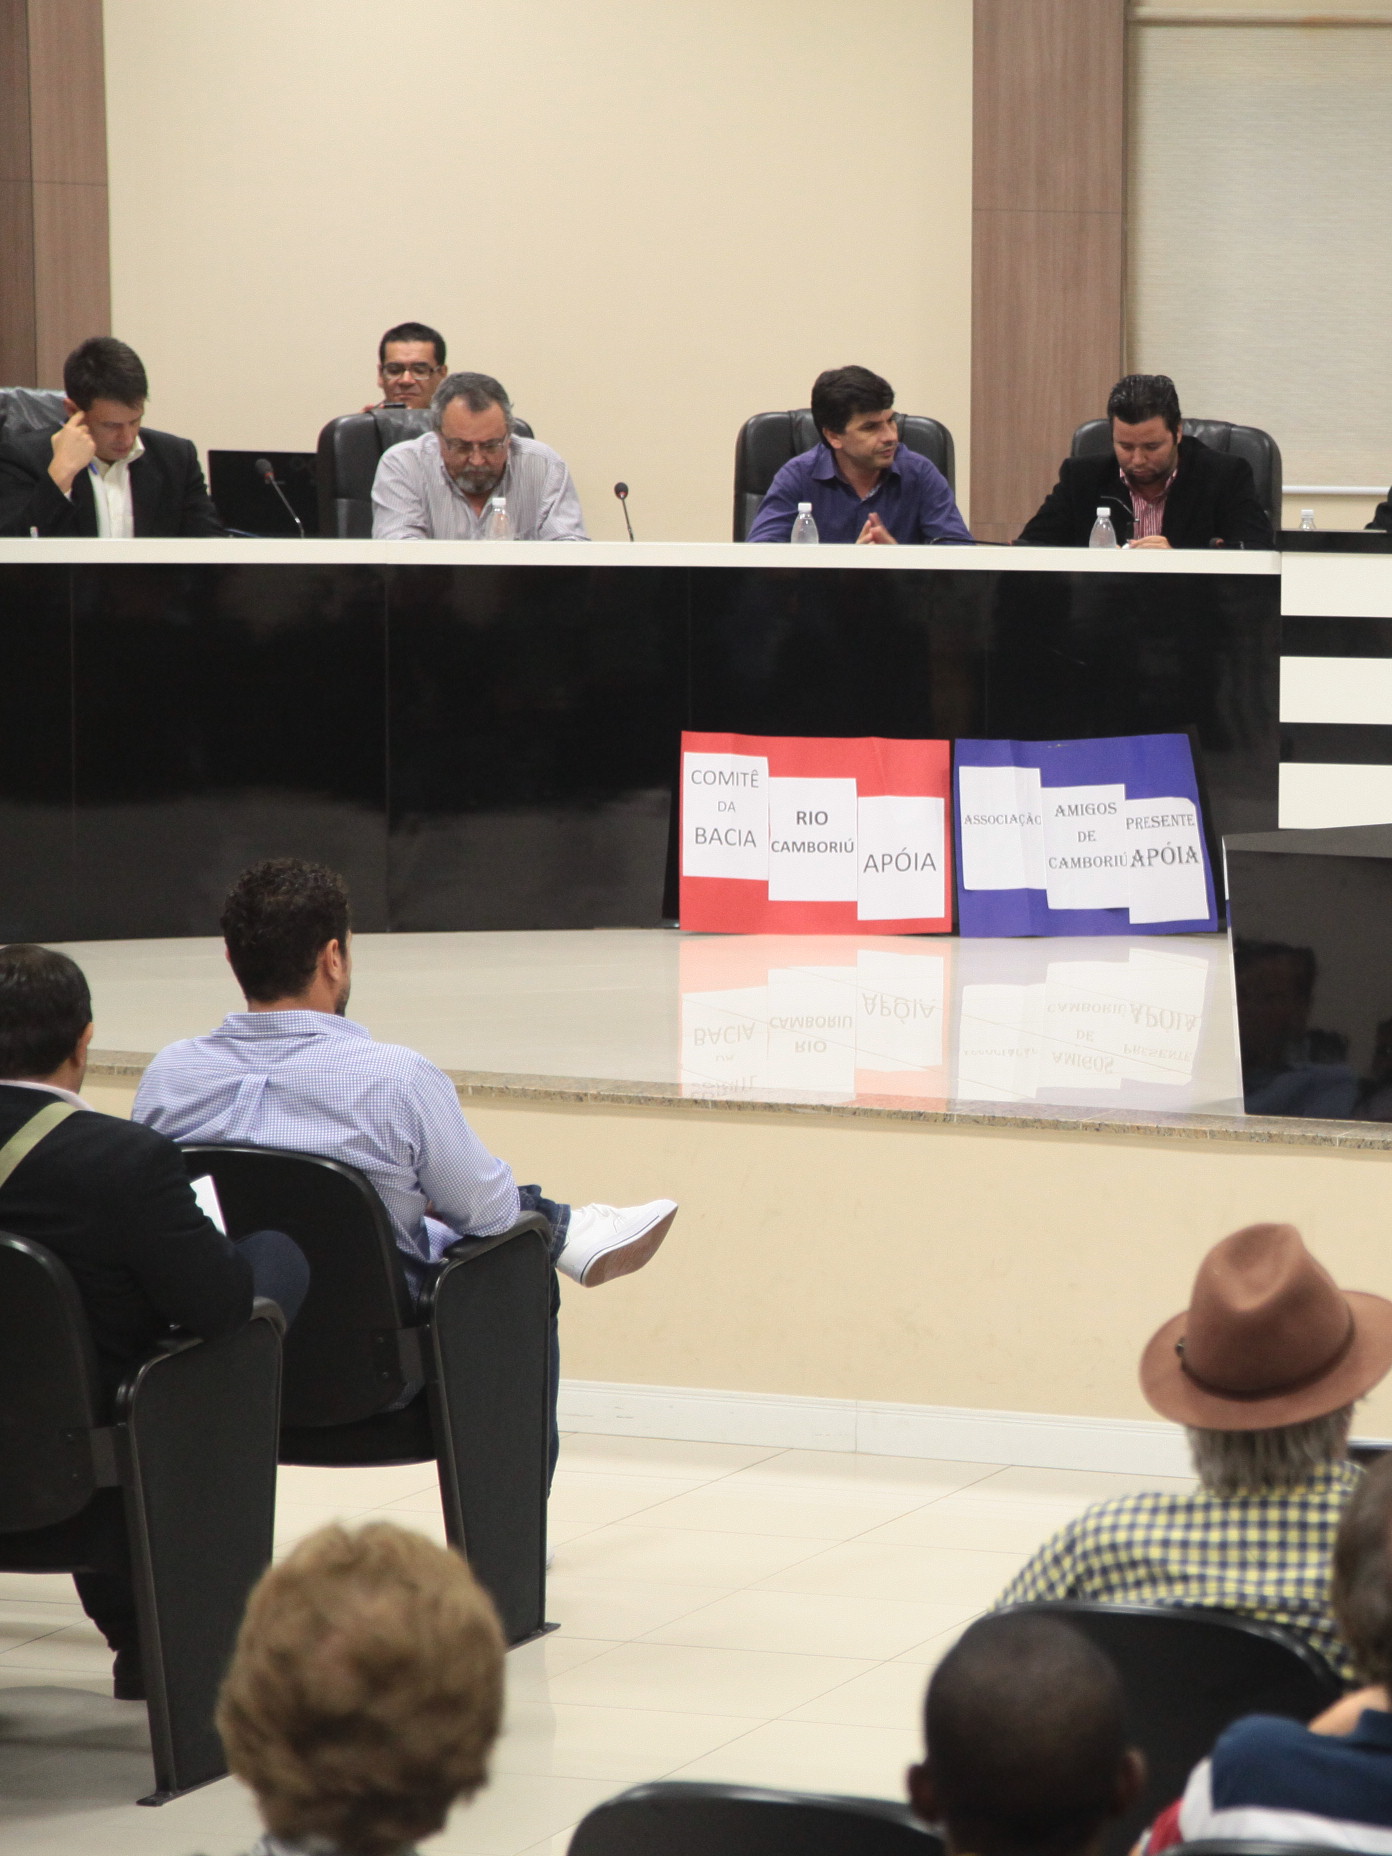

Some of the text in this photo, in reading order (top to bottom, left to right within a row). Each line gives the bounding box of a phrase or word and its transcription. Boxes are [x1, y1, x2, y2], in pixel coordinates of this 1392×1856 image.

[690, 768, 760, 789] COMITÊ
[717, 800, 736, 813] DA
[1055, 802, 1117, 817] AMIGOS
[796, 811, 829, 826] RIO
[1126, 814, 1195, 830] PRESENTE
[694, 827, 757, 848] BACIA
[1077, 831, 1096, 842] DE
[770, 838, 855, 854] CAMBORIÚ
[863, 847, 937, 873] APÓIA
[1048, 852, 1128, 869] CAMBORIÚ
[1130, 842, 1199, 868] APÓIA
